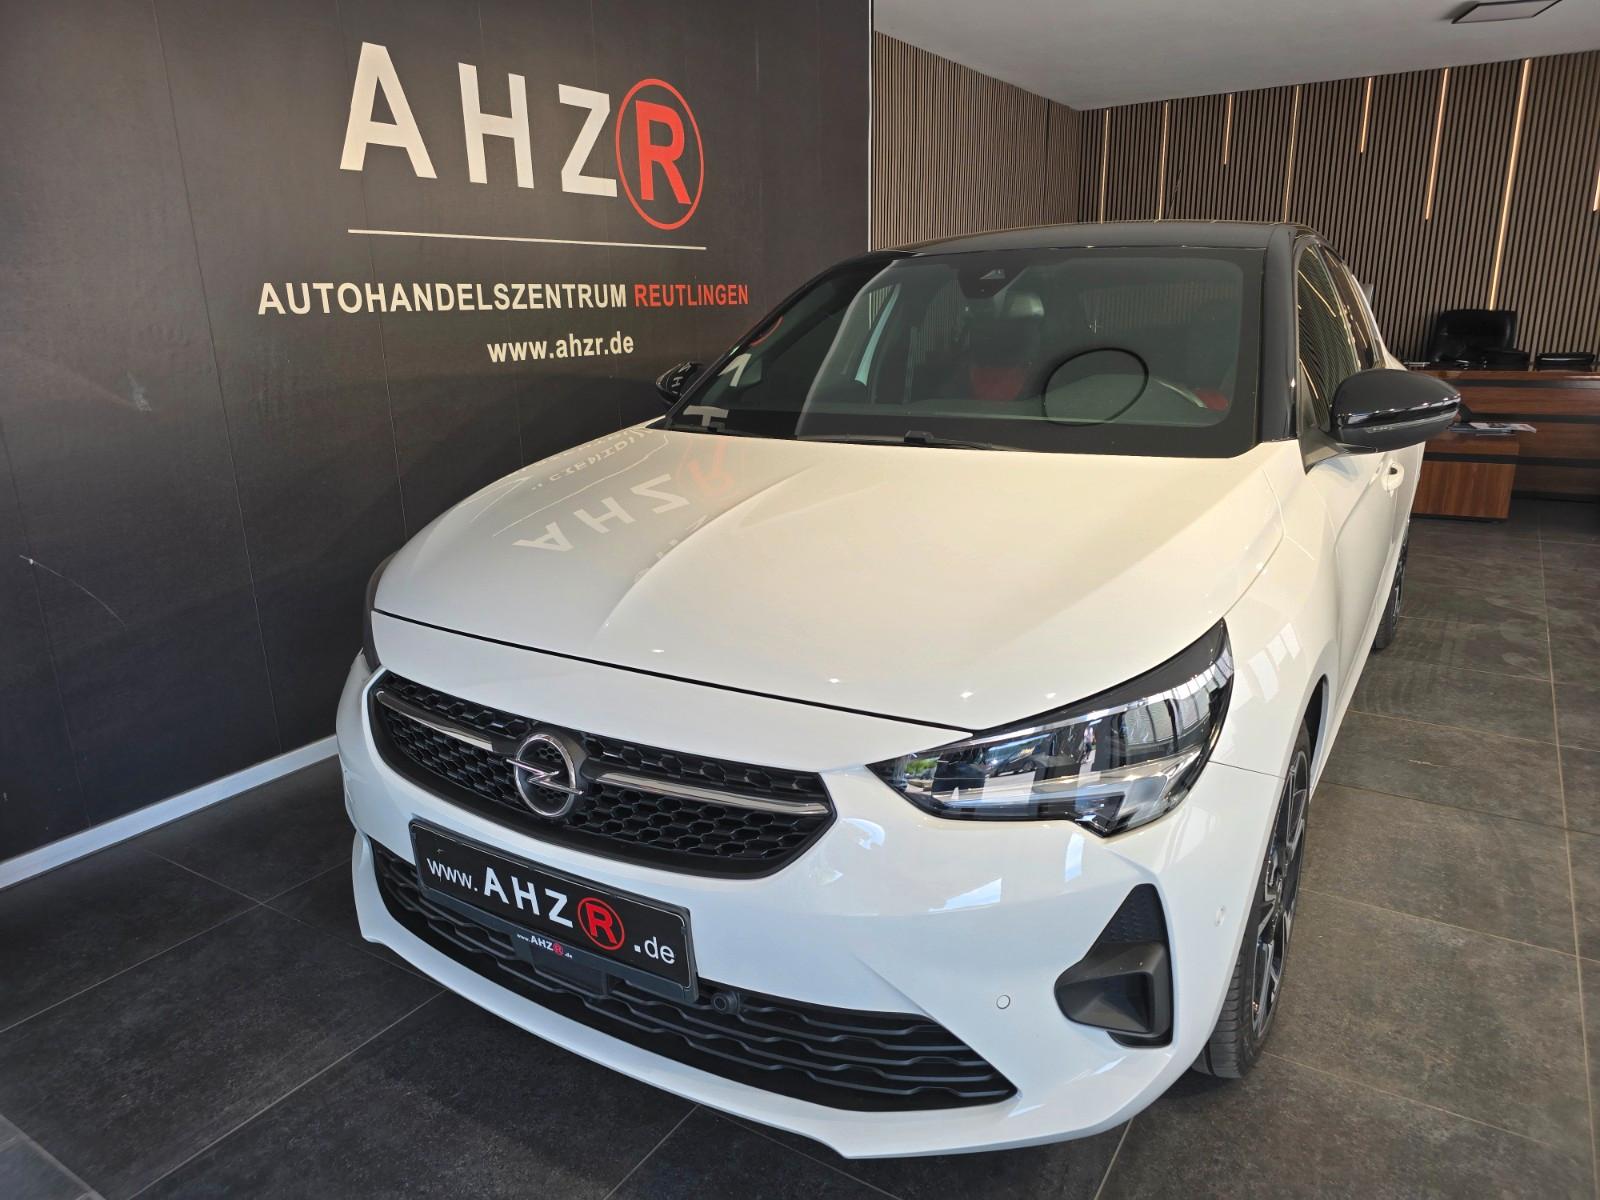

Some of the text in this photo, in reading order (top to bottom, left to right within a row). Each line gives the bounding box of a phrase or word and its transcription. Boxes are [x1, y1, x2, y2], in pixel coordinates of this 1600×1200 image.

[258, 282, 749, 315] AUTOHANDELSZENTRUM REUTLINGEN
[487, 331, 634, 363] www.ahzr.de
